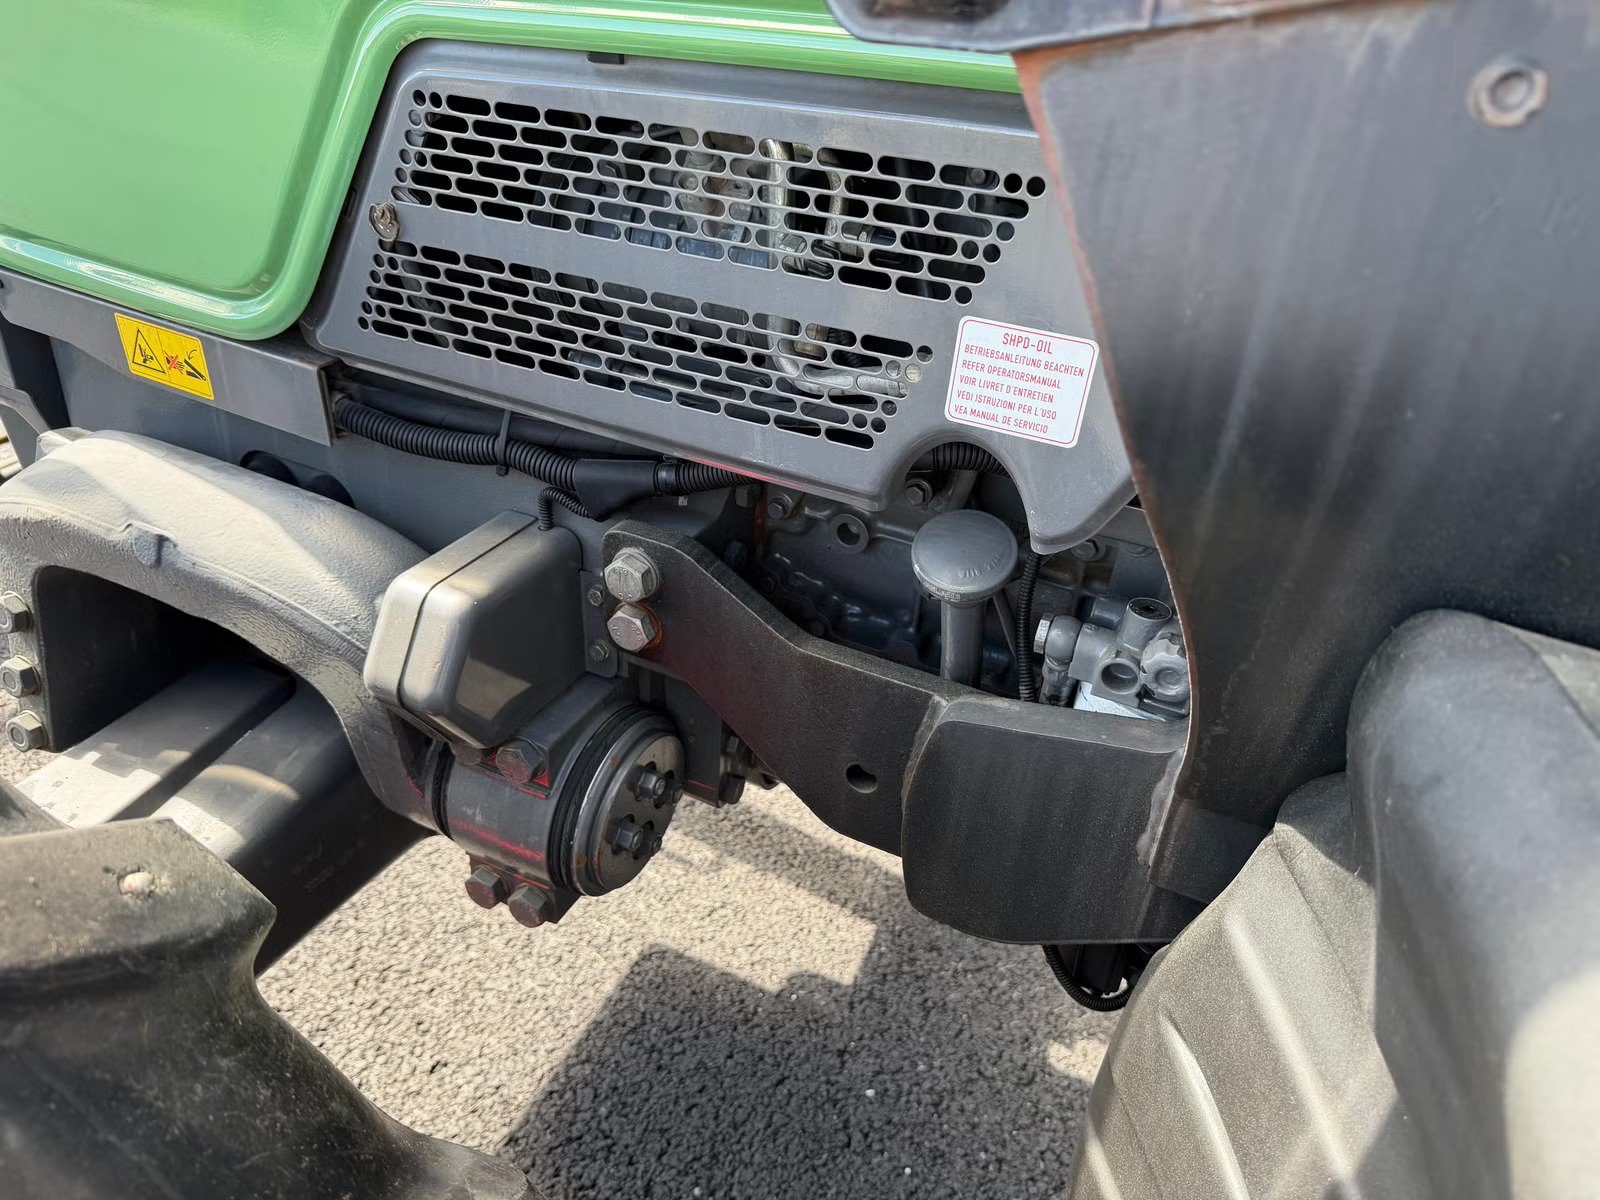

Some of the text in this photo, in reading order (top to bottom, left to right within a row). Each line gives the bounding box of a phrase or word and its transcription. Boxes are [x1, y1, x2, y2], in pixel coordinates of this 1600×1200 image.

[1002, 332, 1053, 354] SHPD-OIL
[964, 344, 1085, 377] BETRIEBSANLEITUNG BEACHTEN
[959, 375, 977, 387] VOIR
[978, 379, 1005, 393] LIVRET
[961, 360, 1061, 389] REFER OPERATORSMANUAL
[957, 390, 974, 401] VEDI
[974, 394, 1016, 411] ISTRUZIONI
[1017, 404, 1033, 415] PER
[954, 404, 1049, 434] VEA MANUAL DE SERVICIO
